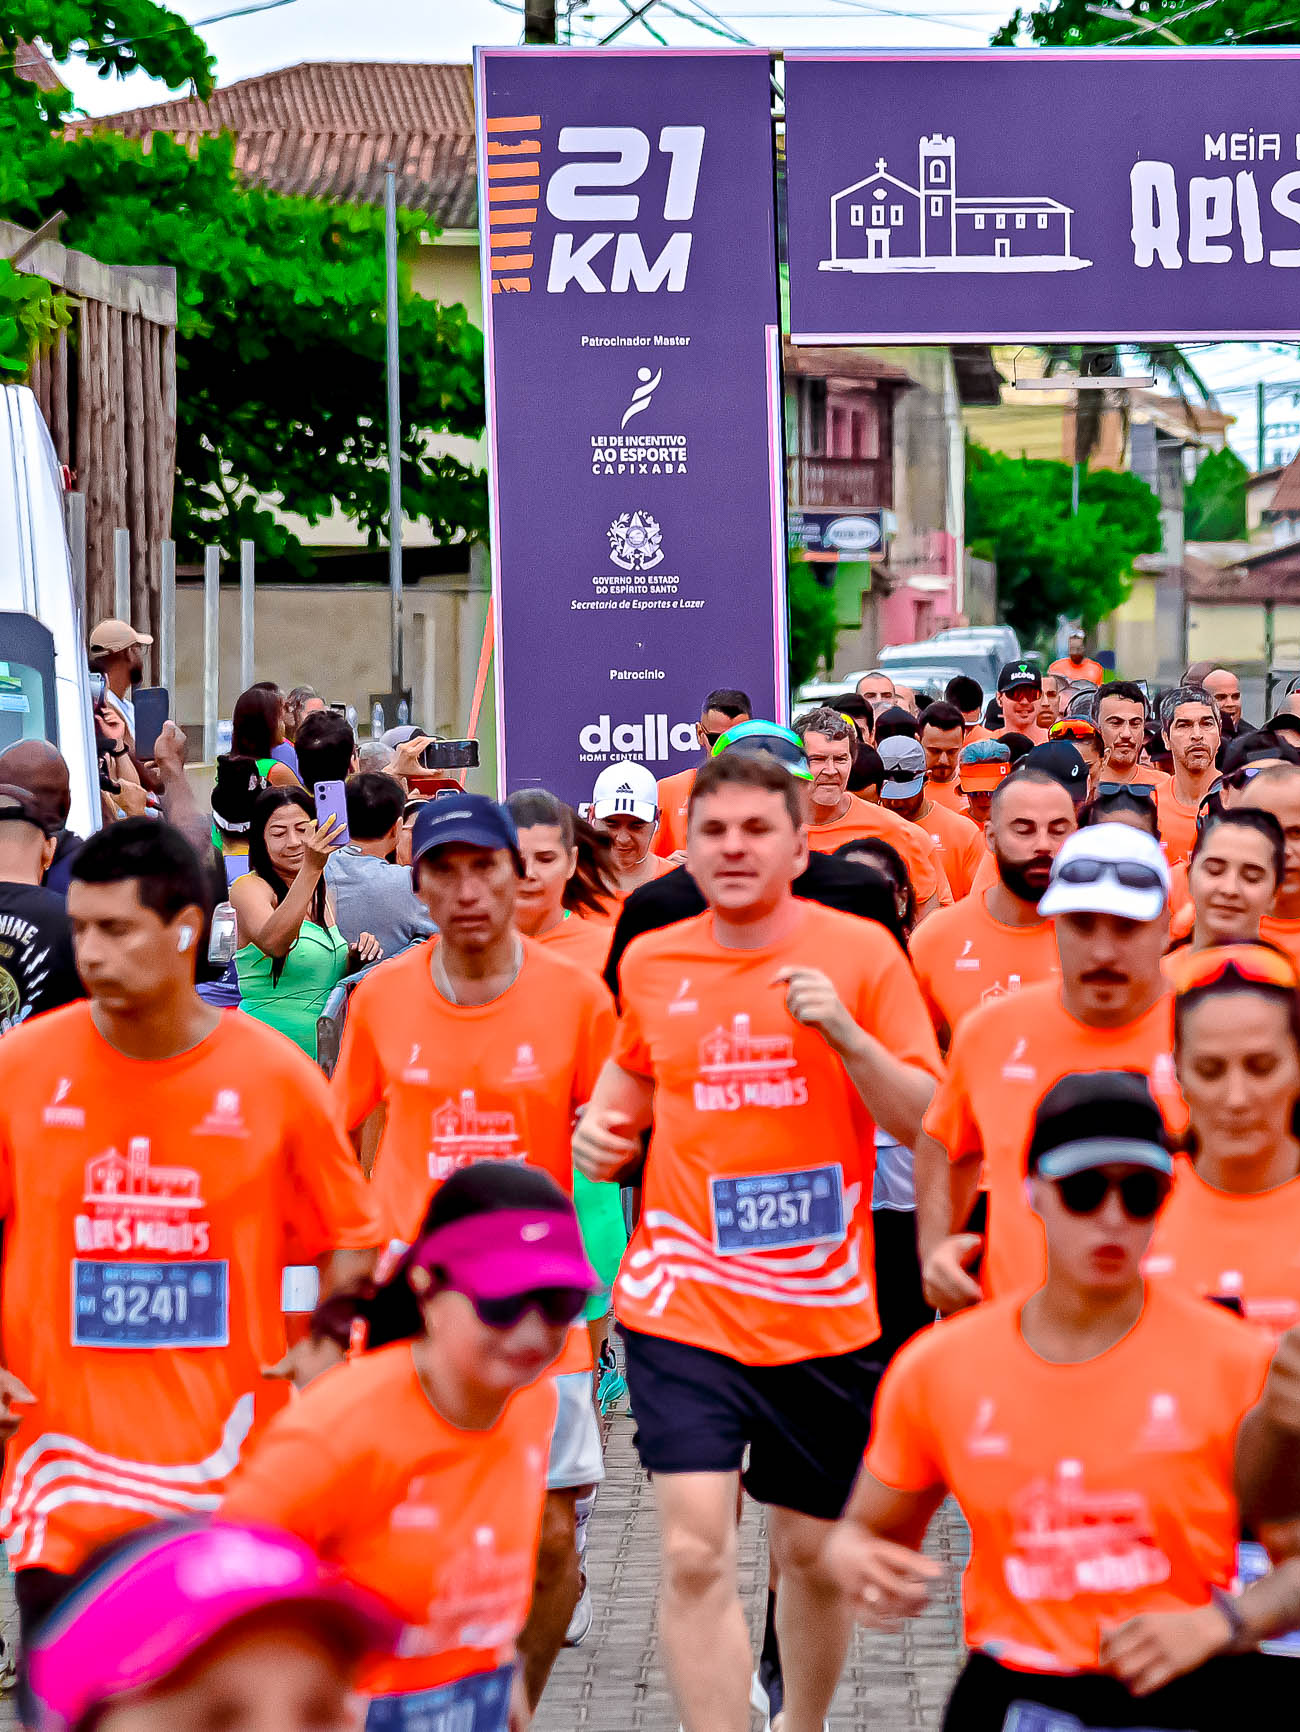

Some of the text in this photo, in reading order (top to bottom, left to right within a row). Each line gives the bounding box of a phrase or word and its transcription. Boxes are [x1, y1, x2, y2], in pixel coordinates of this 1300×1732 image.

[1204, 127, 1281, 161] MEIA
[546, 125, 706, 222] 21
[546, 232, 693, 294] KM
[581, 335, 691, 347] Patrocinador Master
[591, 435, 687, 447] LEI DE INCENTIVO
[592, 447, 687, 463] AO ESPORTE
[592, 463, 687, 475] CAPIXABA
[592, 575, 680, 585] GOVERNO DO ESTADO
[595, 585, 608, 595] DO
[649, 584, 678, 594] SANTO
[570, 599, 705, 611] Secretaria de Esportes e Lazer
[579, 714, 701, 761] dalla
[579, 753, 644, 762] HOME CENTER
[736, 1189, 812, 1232] 3257
[101, 1284, 189, 1327] 3241
